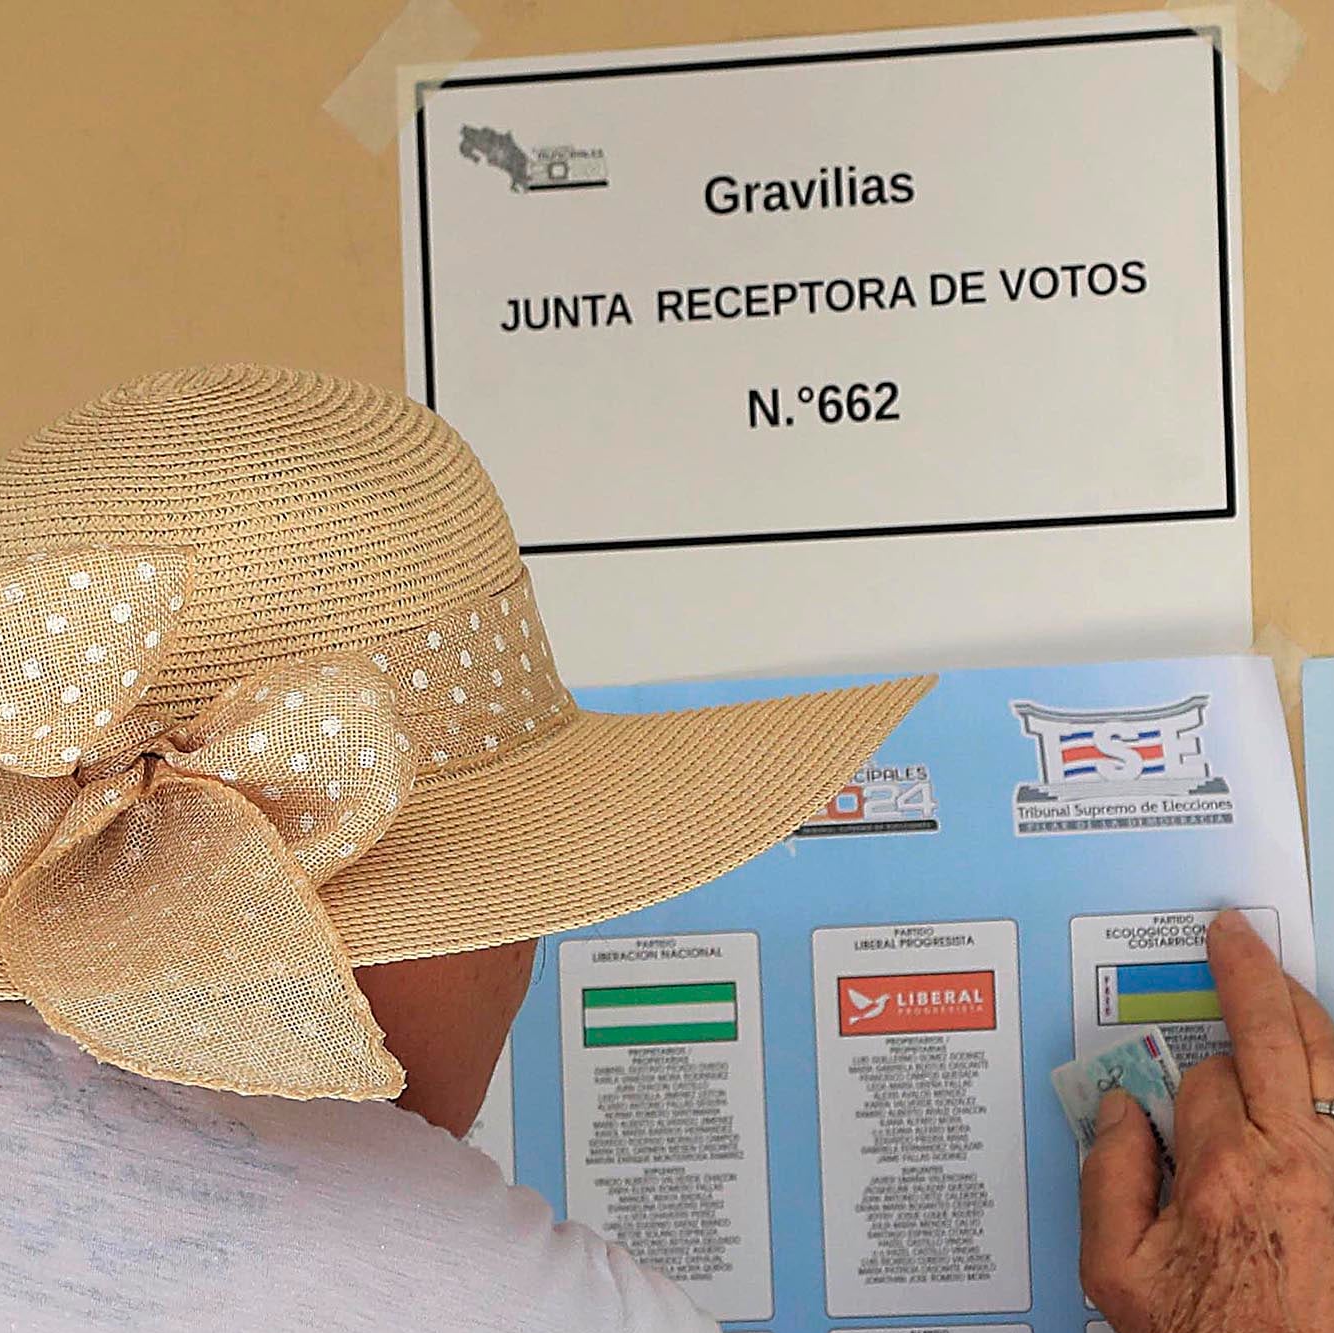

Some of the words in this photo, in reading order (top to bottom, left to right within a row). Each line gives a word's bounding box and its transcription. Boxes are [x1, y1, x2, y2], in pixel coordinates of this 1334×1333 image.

[704, 166, 916, 216] Gravilias
[500, 292, 632, 333] JUNTA
[656, 278, 916, 322] RECEPTORA
[929, 272, 987, 307] DE
[999, 260, 1148, 302] VOTOS
[747, 381, 901, 430] N.°662
[854, 766, 928, 784] CIPALES
[807, 783, 938, 821] 024
[1018, 803, 1071, 820] Tribunal
[1075, 800, 1137, 818] Supremo
[1141, 799, 1159, 812] de
[1163, 797, 1234, 813] Elecciones
[1154, 915, 1195, 925] PARTIDO
[894, 927, 935, 937] PARTIDO
[854, 937, 896, 951] LIBERAL
[899, 936, 975, 949] PROGRESISTA
[1128, 935, 1206, 950] COSTARRICE
[896, 988, 984, 1007] LIBERAL
